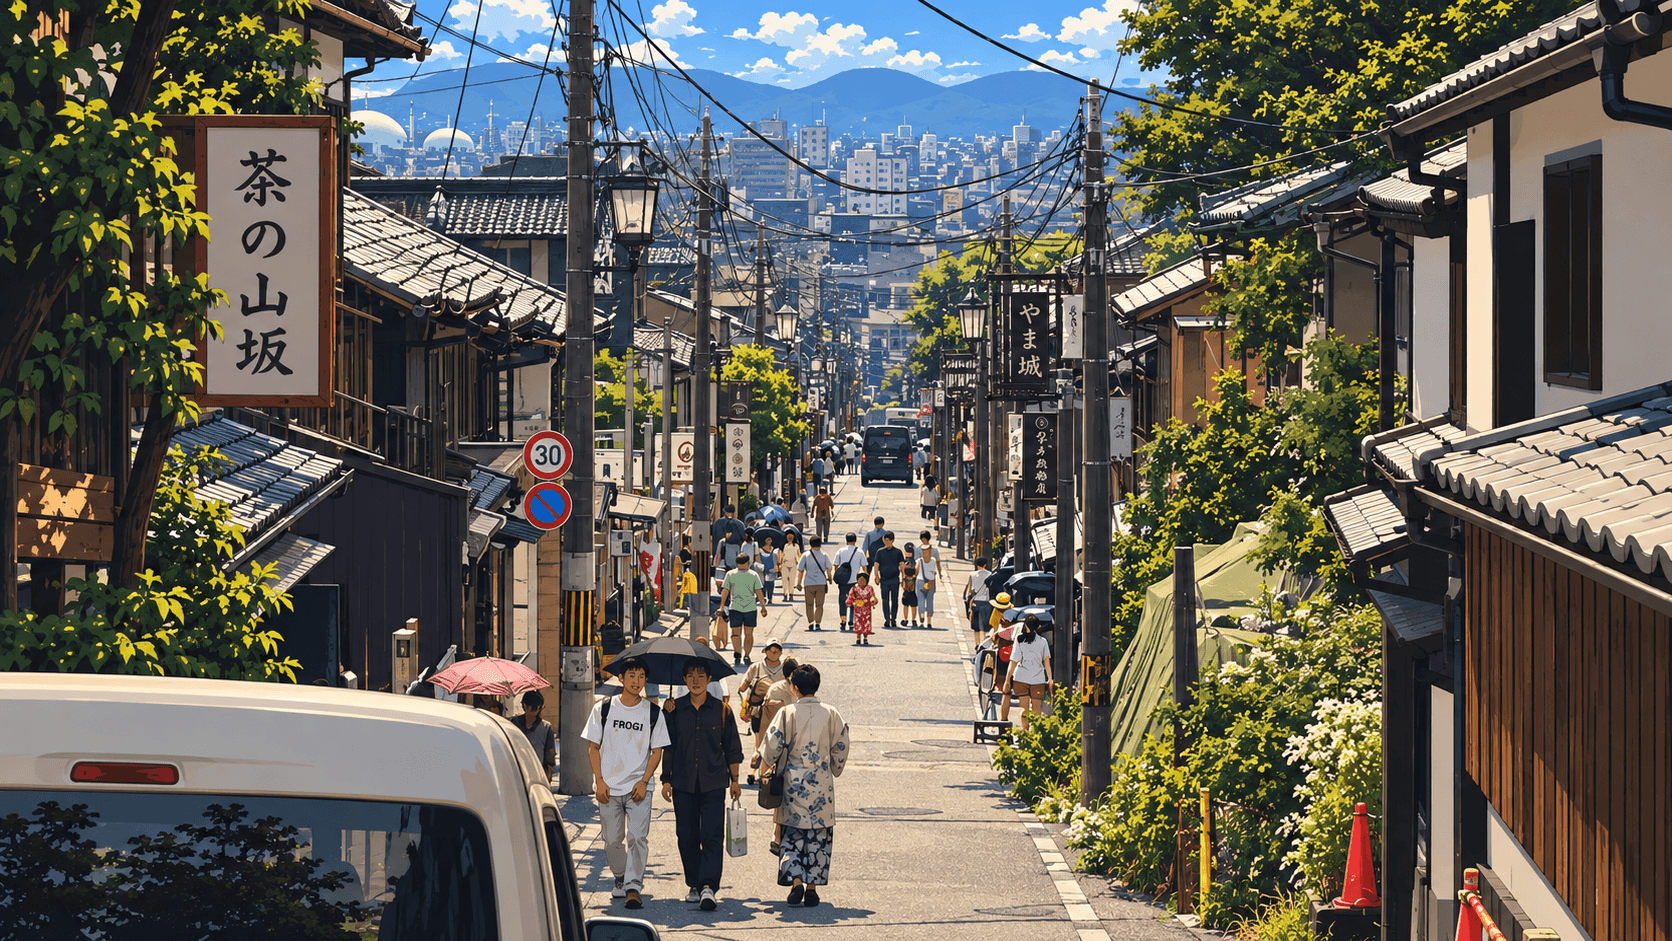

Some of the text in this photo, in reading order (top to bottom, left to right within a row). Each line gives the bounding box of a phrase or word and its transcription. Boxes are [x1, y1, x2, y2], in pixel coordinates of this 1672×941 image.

[234, 149, 293, 376] 茶の山坂
[1018, 303, 1043, 378] やま城
[535, 444, 561, 466] 30
